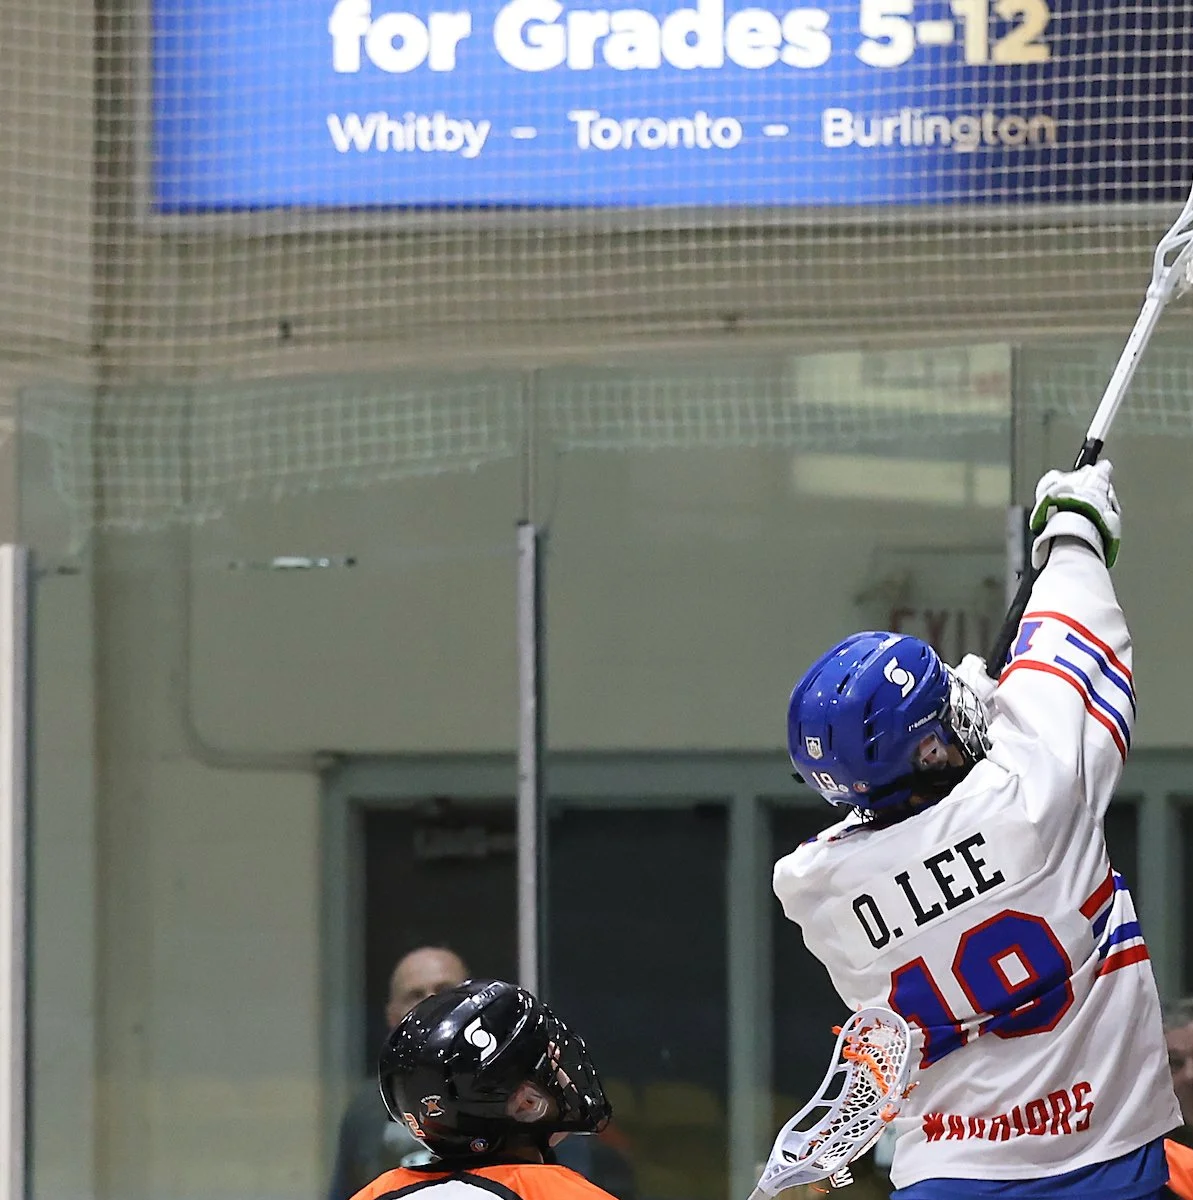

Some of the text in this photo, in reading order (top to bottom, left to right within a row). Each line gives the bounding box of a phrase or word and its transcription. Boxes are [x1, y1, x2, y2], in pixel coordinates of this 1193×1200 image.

[328, 0, 1052, 73] for Grades 5-12
[326, 110, 492, 158] Whitby
[567, 109, 744, 150] Toronto
[821, 107, 1058, 152] Burlington
[895, 833, 1006, 927] LEE
[888, 909, 1075, 1069] 19
